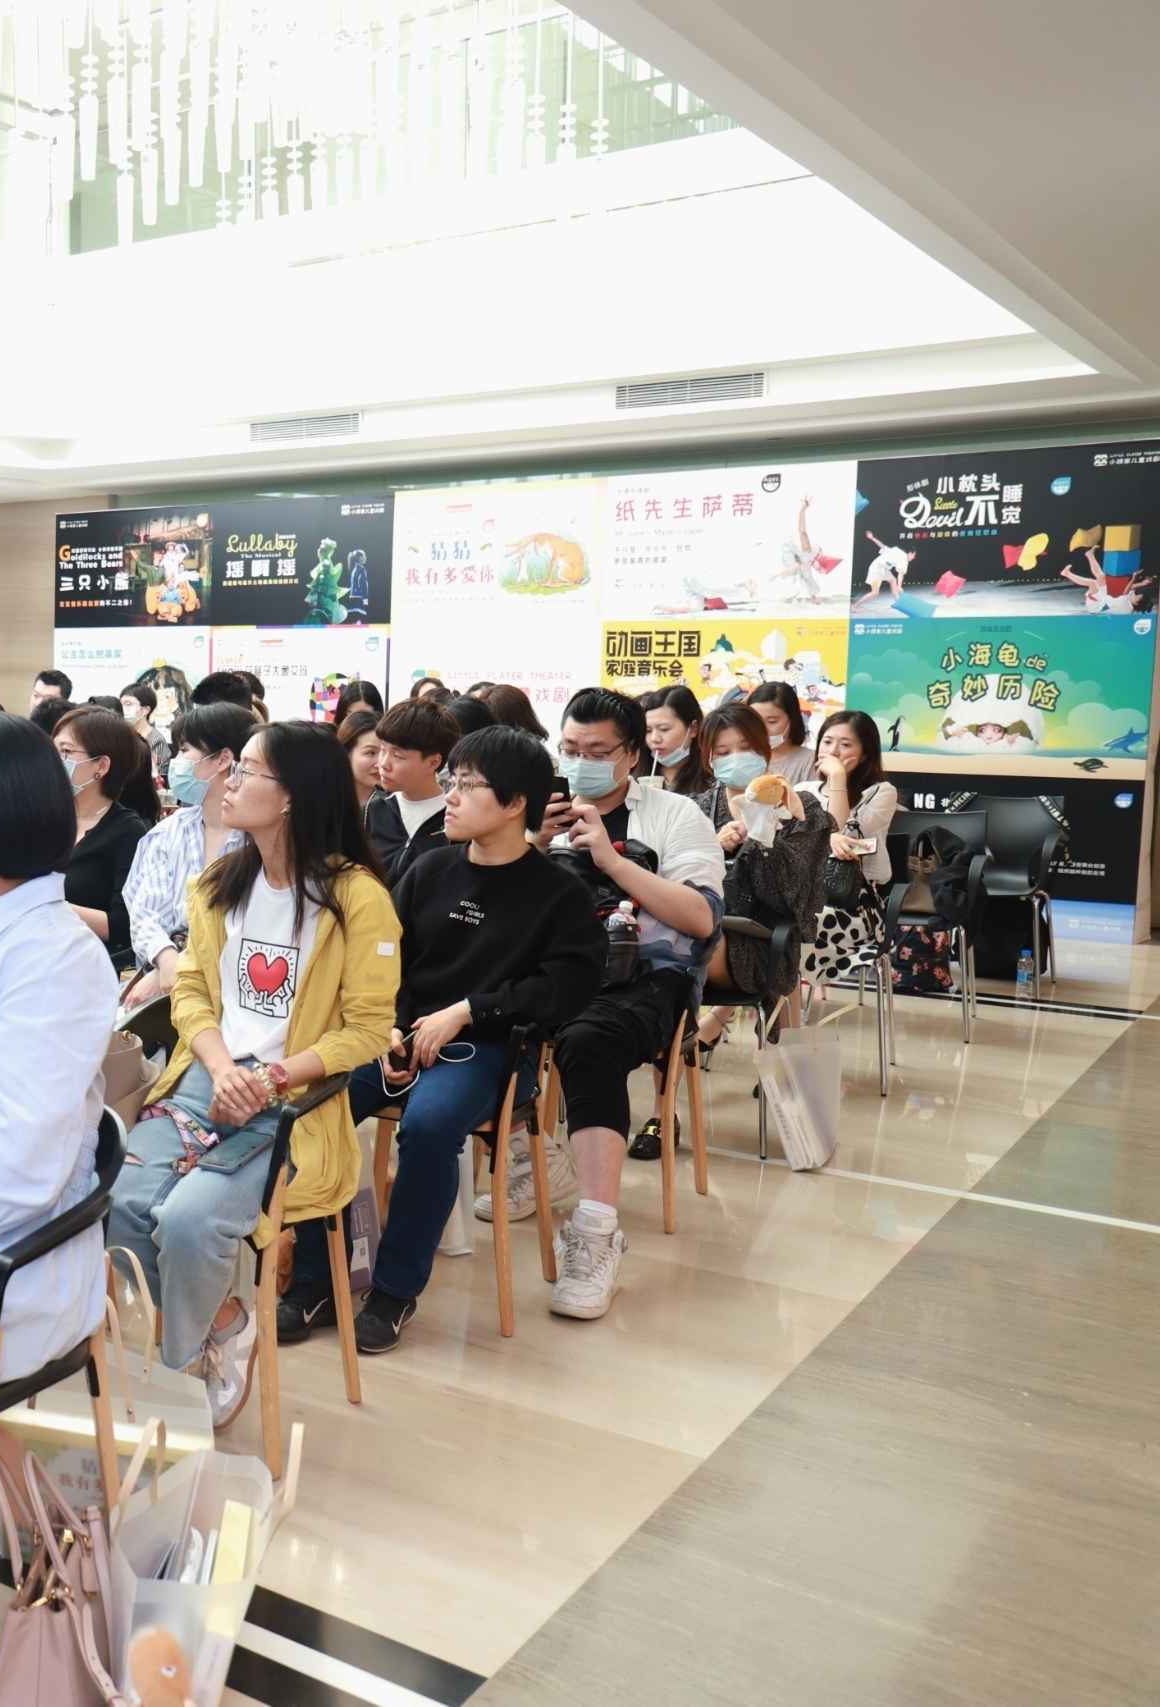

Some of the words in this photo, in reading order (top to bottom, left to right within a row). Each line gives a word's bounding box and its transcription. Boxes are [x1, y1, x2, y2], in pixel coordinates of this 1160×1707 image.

[615, 493, 754, 522] 纸先生萨蒂
[226, 533, 297, 557] Lullaby
[59, 571, 129, 591] 三只小熊
[406, 566, 495, 585] 我有多爱你
[606, 630, 701, 657] 动画王国
[606, 659, 684, 678] 家庭音乐会
[928, 674, 1060, 711] 奇妙历险
